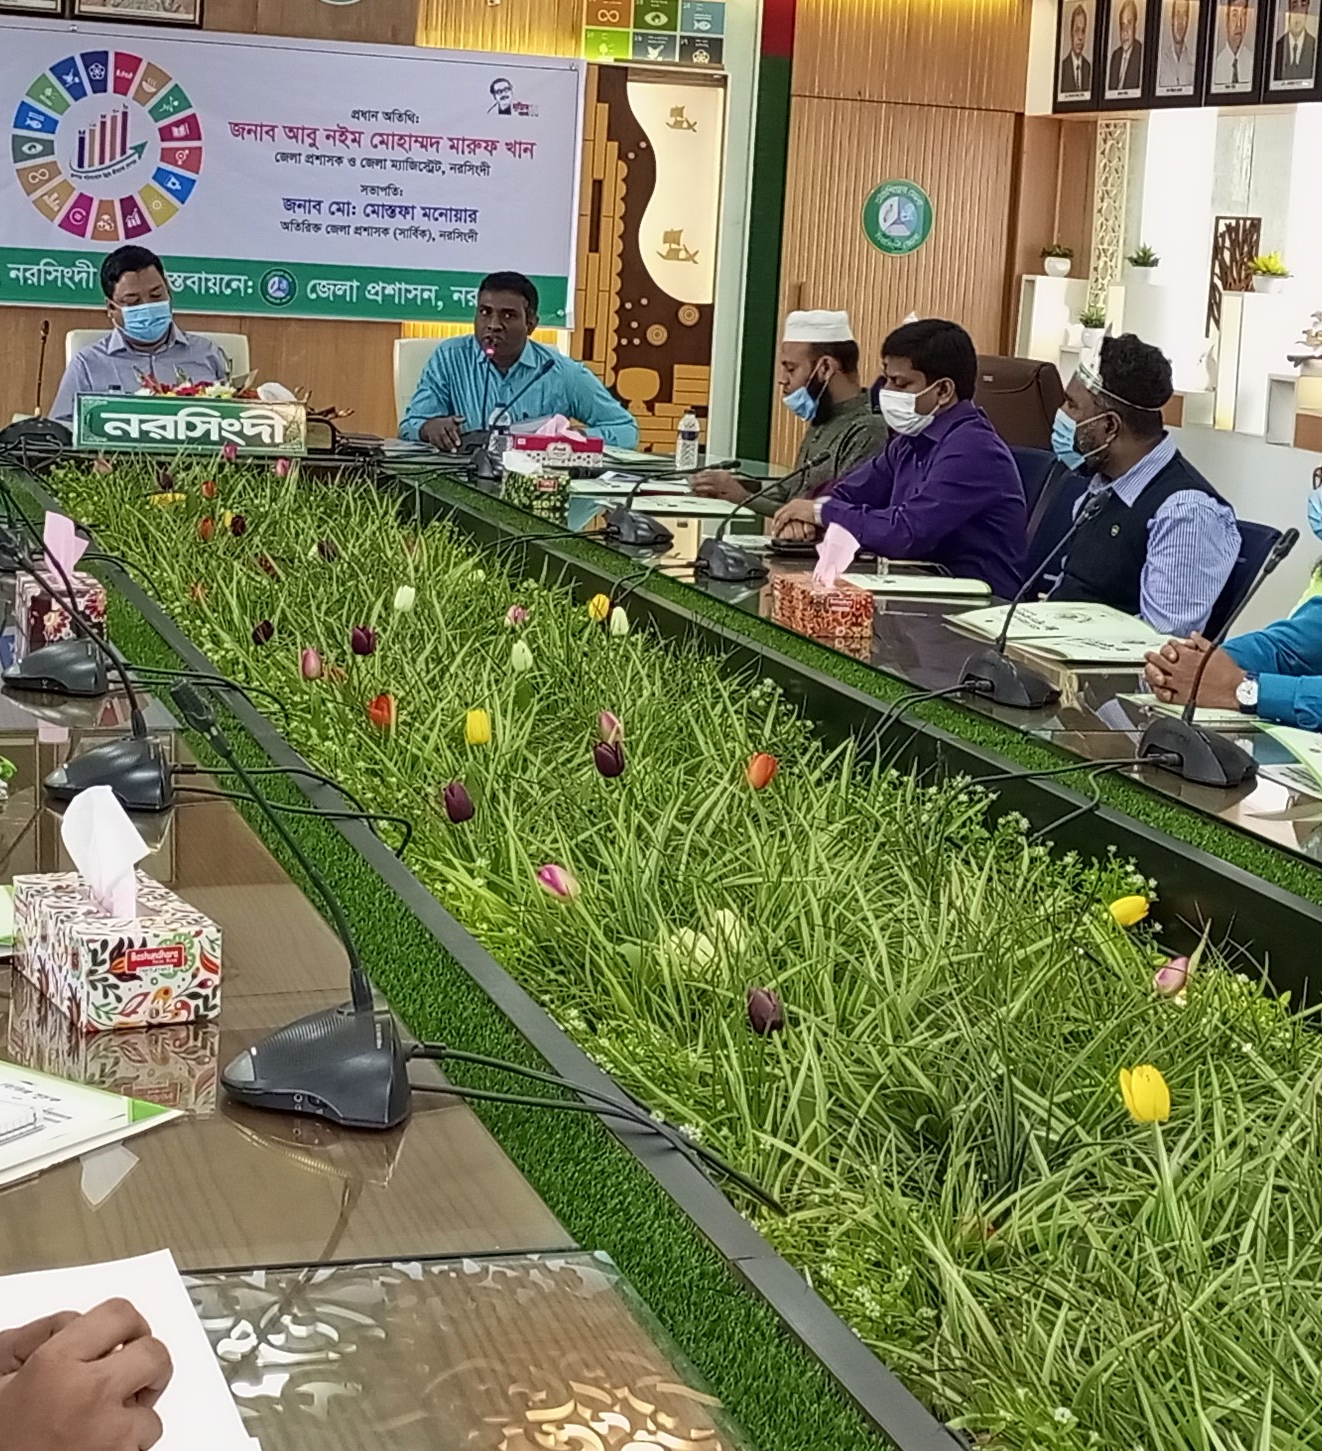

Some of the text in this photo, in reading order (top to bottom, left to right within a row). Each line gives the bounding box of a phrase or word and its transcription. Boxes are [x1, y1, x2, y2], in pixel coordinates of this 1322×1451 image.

[350, 108, 378, 122] প্রধান
[228, 121, 537, 160] জনাব আবু নইম মোহাম্মদ মারুফ খান
[275, 151, 302, 164] জেলা
[305, 153, 344, 168] প্রশাসক
[347, 157, 357, 168] ও
[360, 157, 387, 170] জেলা
[449, 160, 492, 177] নরসিংদী
[282, 197, 325, 216] জনাব
[363, 203, 417, 221] মোস্তফা
[420, 206, 479, 225] মনোয়ার
[280, 219, 322, 232] অতিরিক্ত
[326, 223, 351, 237] জেলা
[354, 225, 391, 238] প্রশাসক
[439, 228, 479, 243] নরসিংদী
[7, 258, 98, 290] নরসিংদী
[306, 277, 361, 303] জেলা
[365, 281, 445, 312] প্রশাসন,
[101, 406, 288, 446] নরসিংদী
